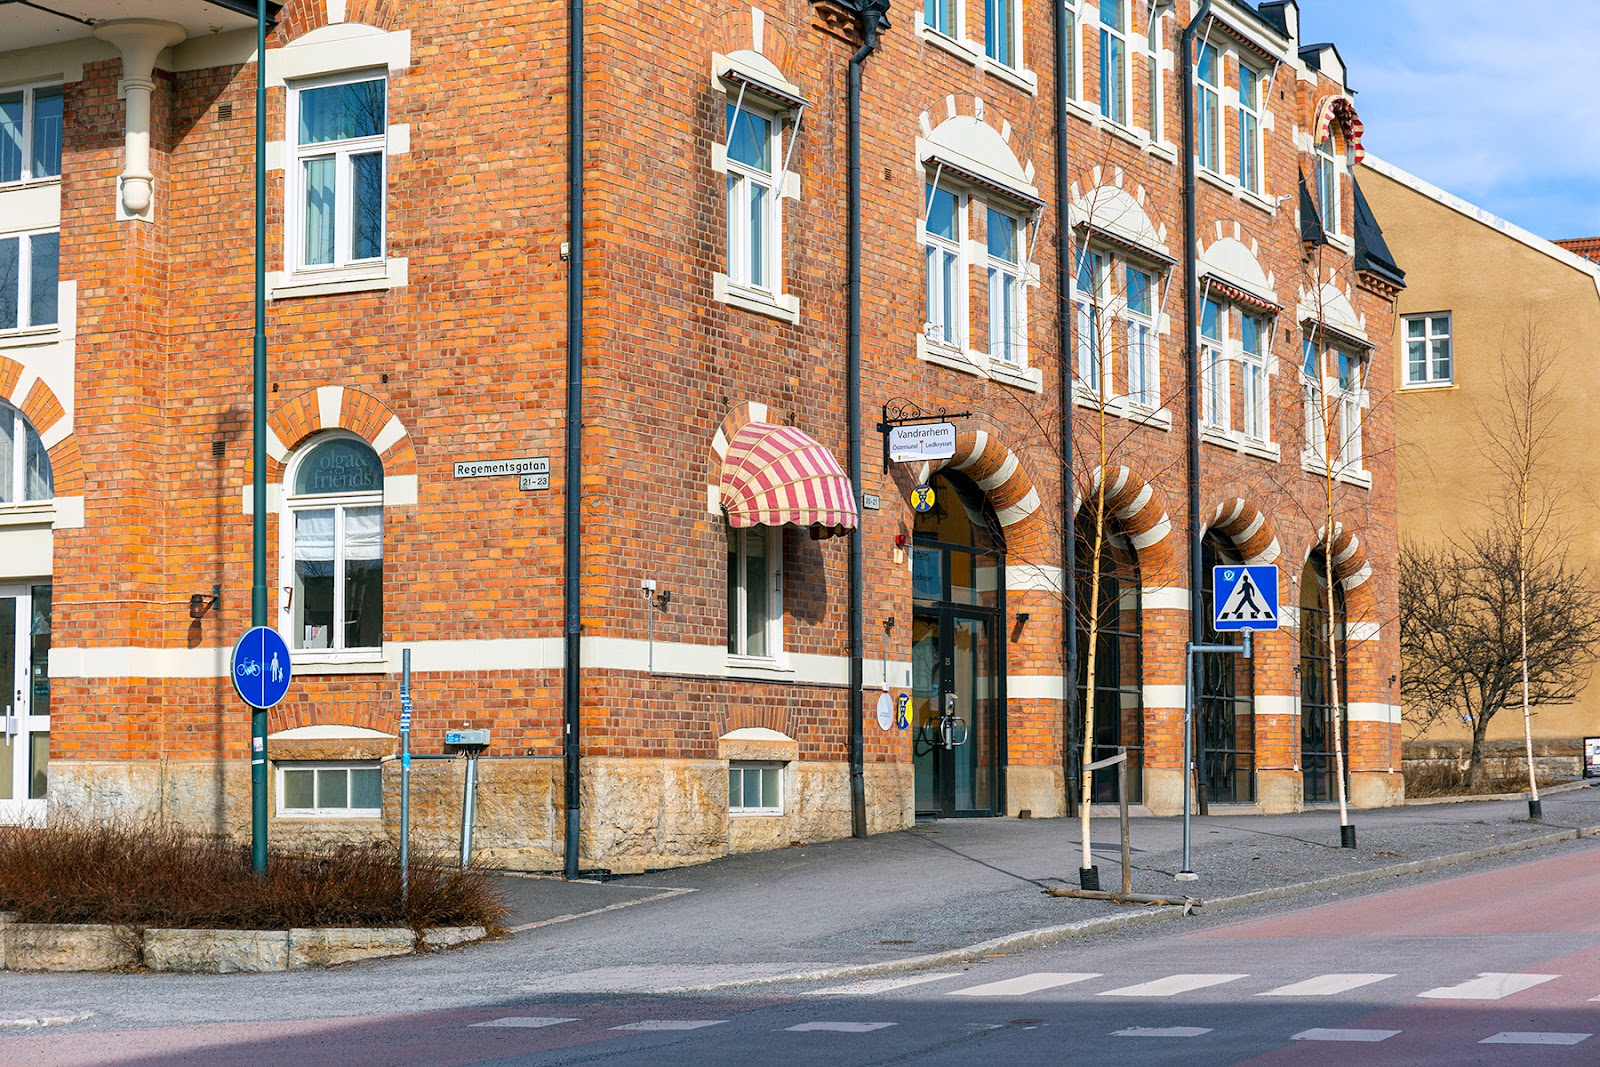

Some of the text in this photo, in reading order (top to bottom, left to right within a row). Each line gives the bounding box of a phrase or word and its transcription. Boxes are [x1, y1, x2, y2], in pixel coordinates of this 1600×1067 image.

[897, 427, 949, 439] Vandrarhem
[925, 440, 953, 449] Ledkrysset
[457, 461, 546, 476] Regementsgatan
[313, 468, 372, 489] friends
[522, 478, 548, 486] 21-23
